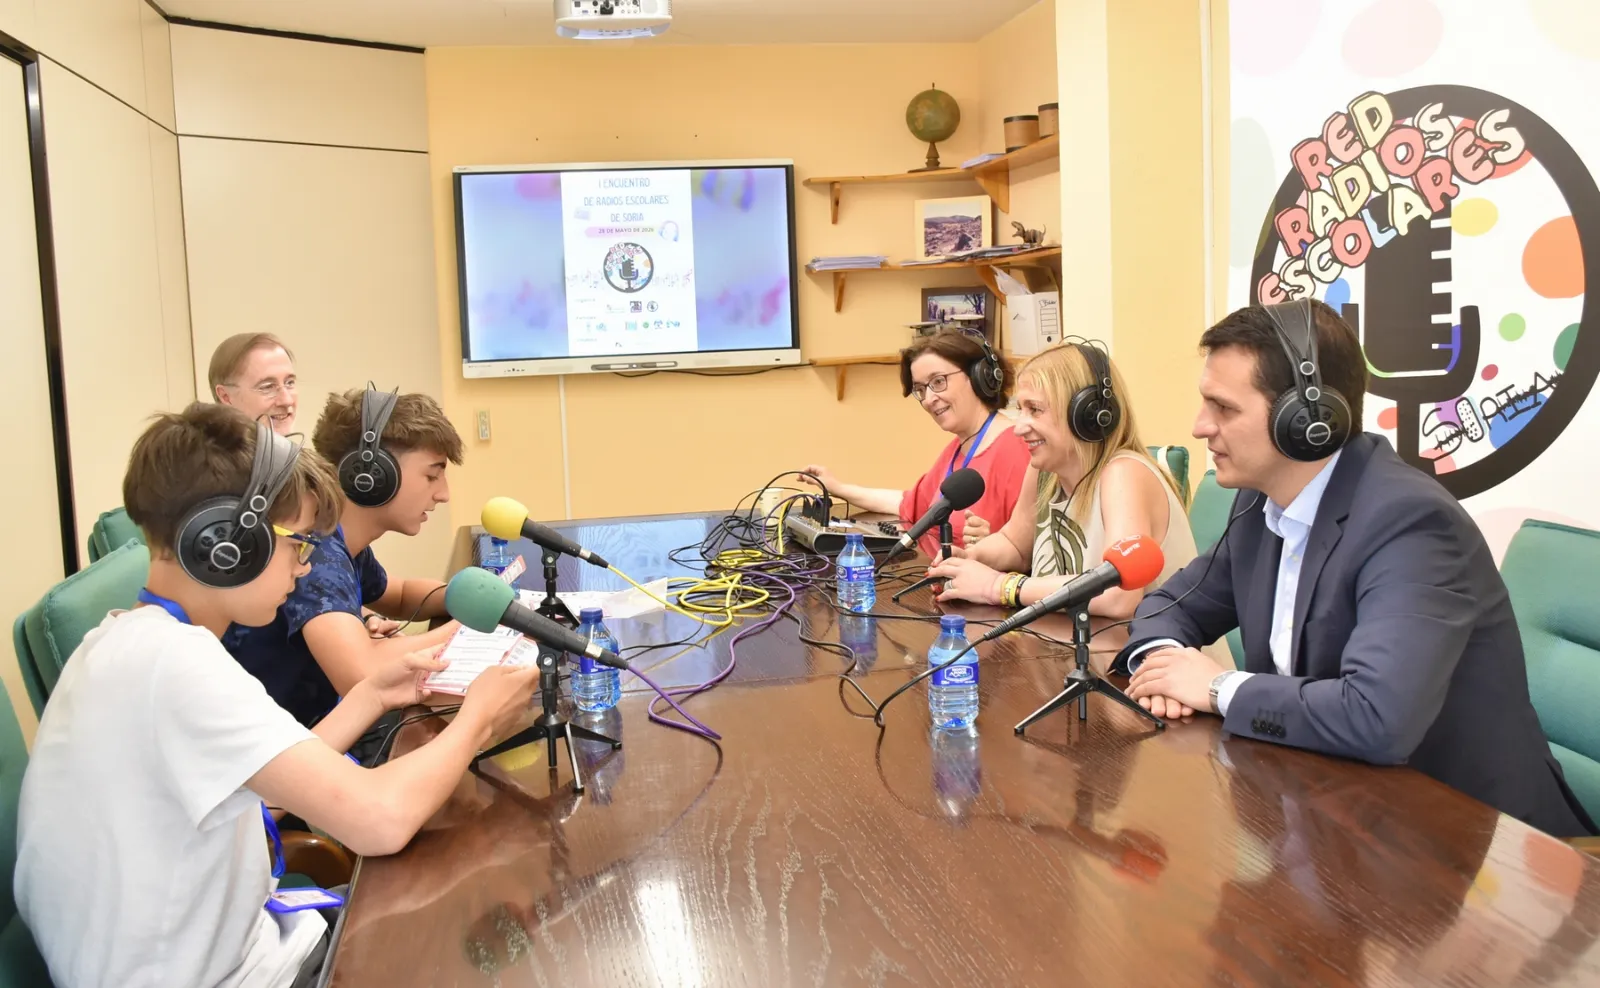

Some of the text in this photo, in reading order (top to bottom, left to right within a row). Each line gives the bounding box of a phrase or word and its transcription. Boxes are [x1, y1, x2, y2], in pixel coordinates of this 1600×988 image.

[603, 177, 651, 189] ENCUENTRO
[1274, 102, 1455, 258] RADIOS
[1290, 90, 1393, 190] RED
[584, 195, 669, 206] DE RADIOS ESCOLARES
[610, 213, 644, 222] DE SORIA
[1258, 108, 1526, 305] ESCOLARES
[1422, 370, 1564, 461] SORIA
